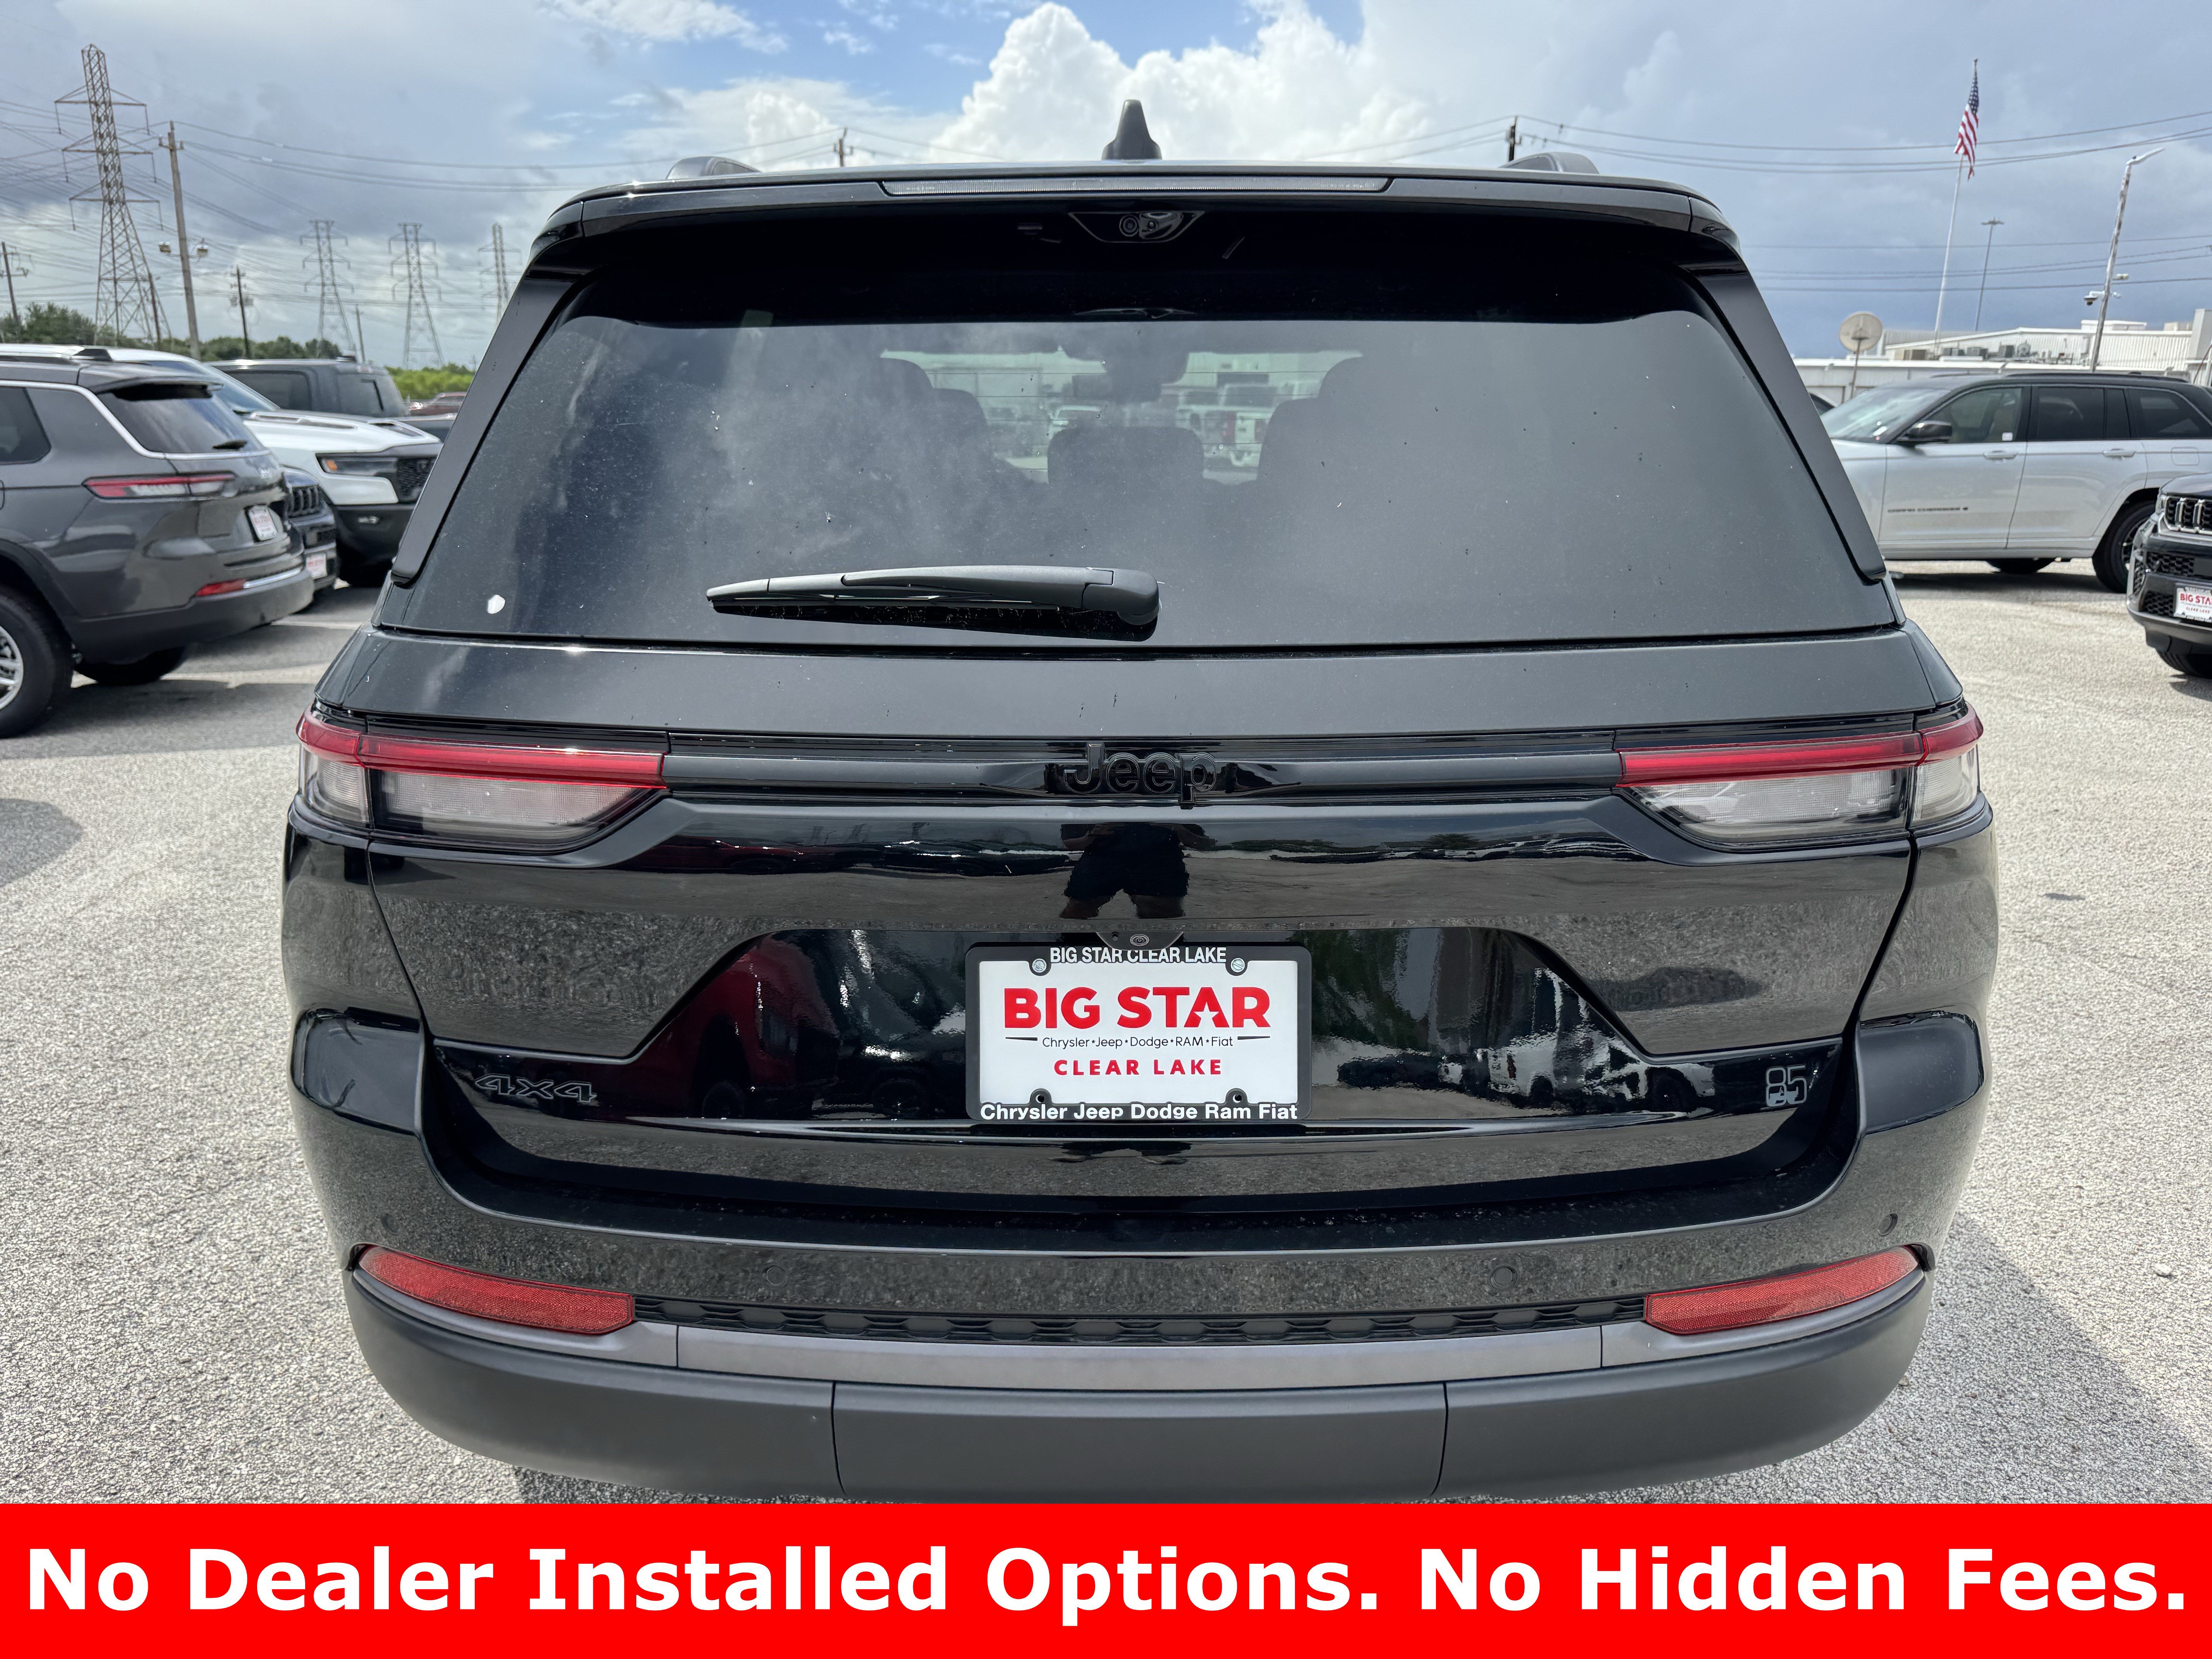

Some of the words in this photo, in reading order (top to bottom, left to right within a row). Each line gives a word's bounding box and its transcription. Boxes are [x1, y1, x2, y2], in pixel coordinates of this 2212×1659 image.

[2180, 593, 2193, 602] BIG
[2195, 595, 2212, 605] STA
[1063, 743, 1217, 805] Jeep
[1050, 947, 1078, 962] BIG
[1082, 947, 1124, 962] STAR
[1127, 947, 1181, 962] CLEAR
[1185, 947, 1227, 962] LAKE
[1004, 987, 1100, 1029] BIG
[1117, 986, 1271, 1029] STAR
[1042, 1037, 1090, 1050] Chrysler
[1095, 1037, 1123, 1049] Jeep
[1130, 1036, 1169, 1049] Dodge
[1175, 1036, 1204, 1046] RAM
[1211, 1036, 1233, 1046] Fiat
[1054, 1059, 1140, 1076] CLEAR
[1154, 1059, 1222, 1075] LAKE
[1766, 1065, 1807, 1107] 85
[980, 1104, 1068, 1120] Chrysler
[1073, 1104, 1123, 1120] Jeep
[1131, 1103, 1198, 1119] Dodge
[1205, 1103, 1251, 1119] Ram
[1259, 1103, 1298, 1119] Fiat
